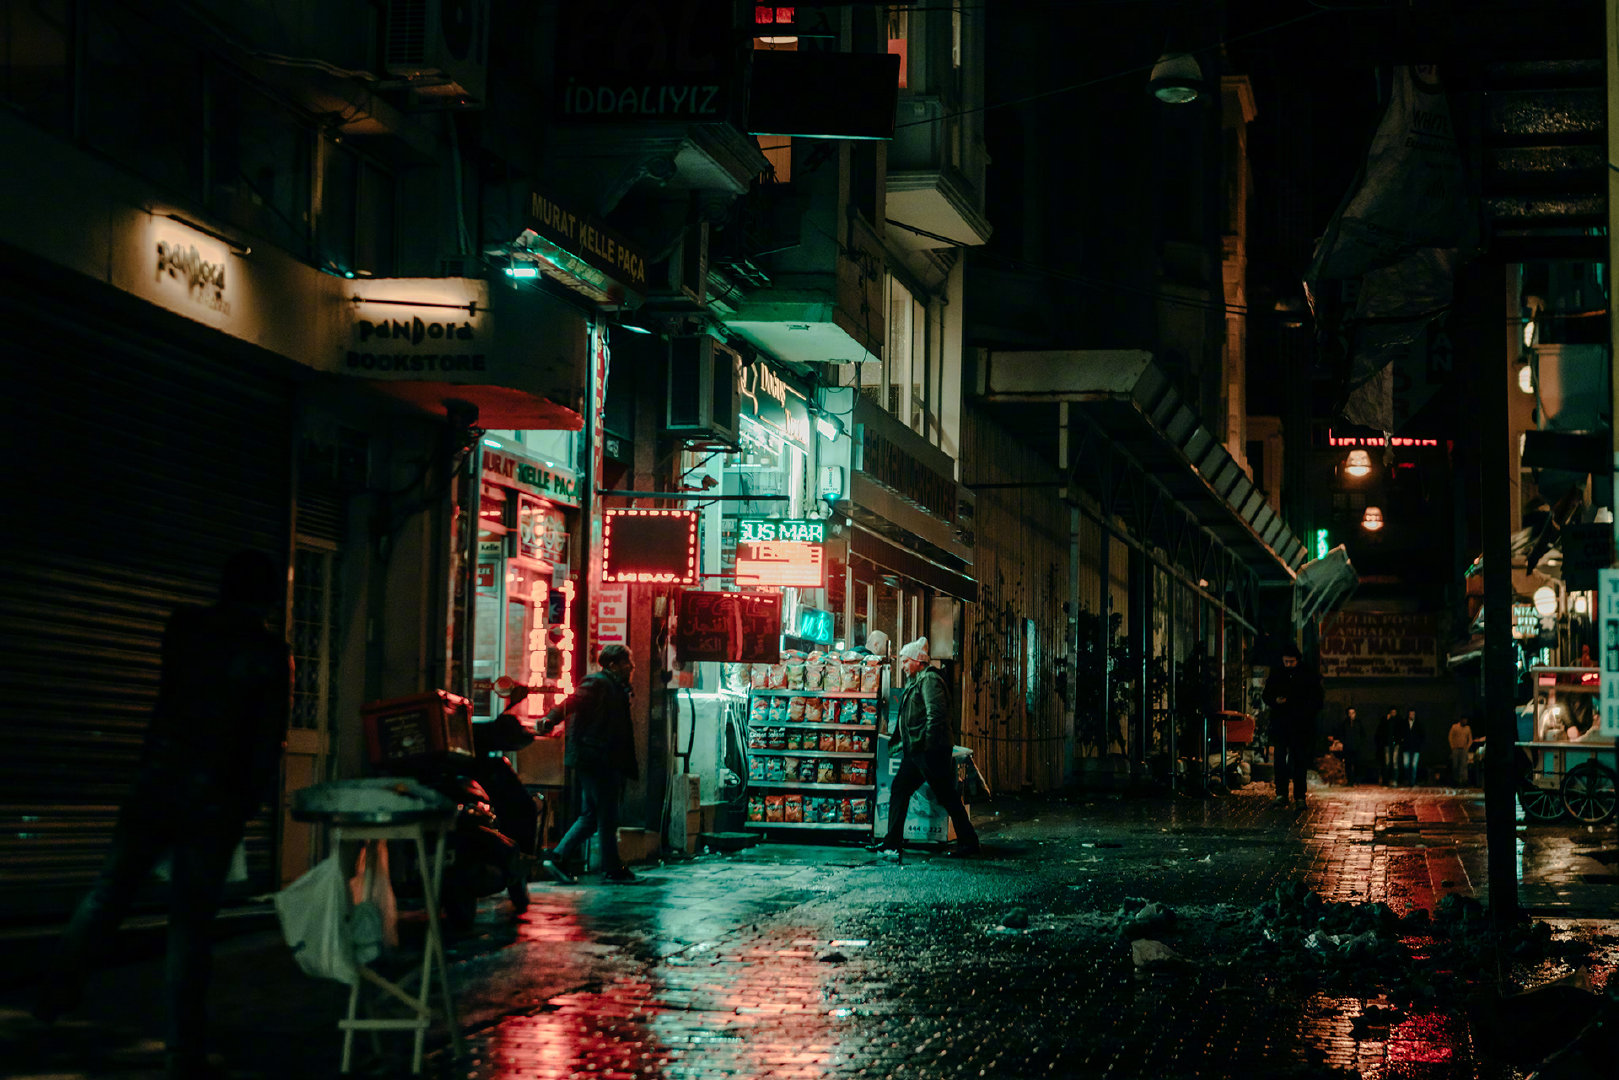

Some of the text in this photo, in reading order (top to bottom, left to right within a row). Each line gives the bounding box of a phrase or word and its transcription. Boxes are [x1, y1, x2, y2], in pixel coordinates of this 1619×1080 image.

[532, 191, 645, 284] MURAT KELLE PAÇA
[347, 351, 486, 371] BOOKSTORE
